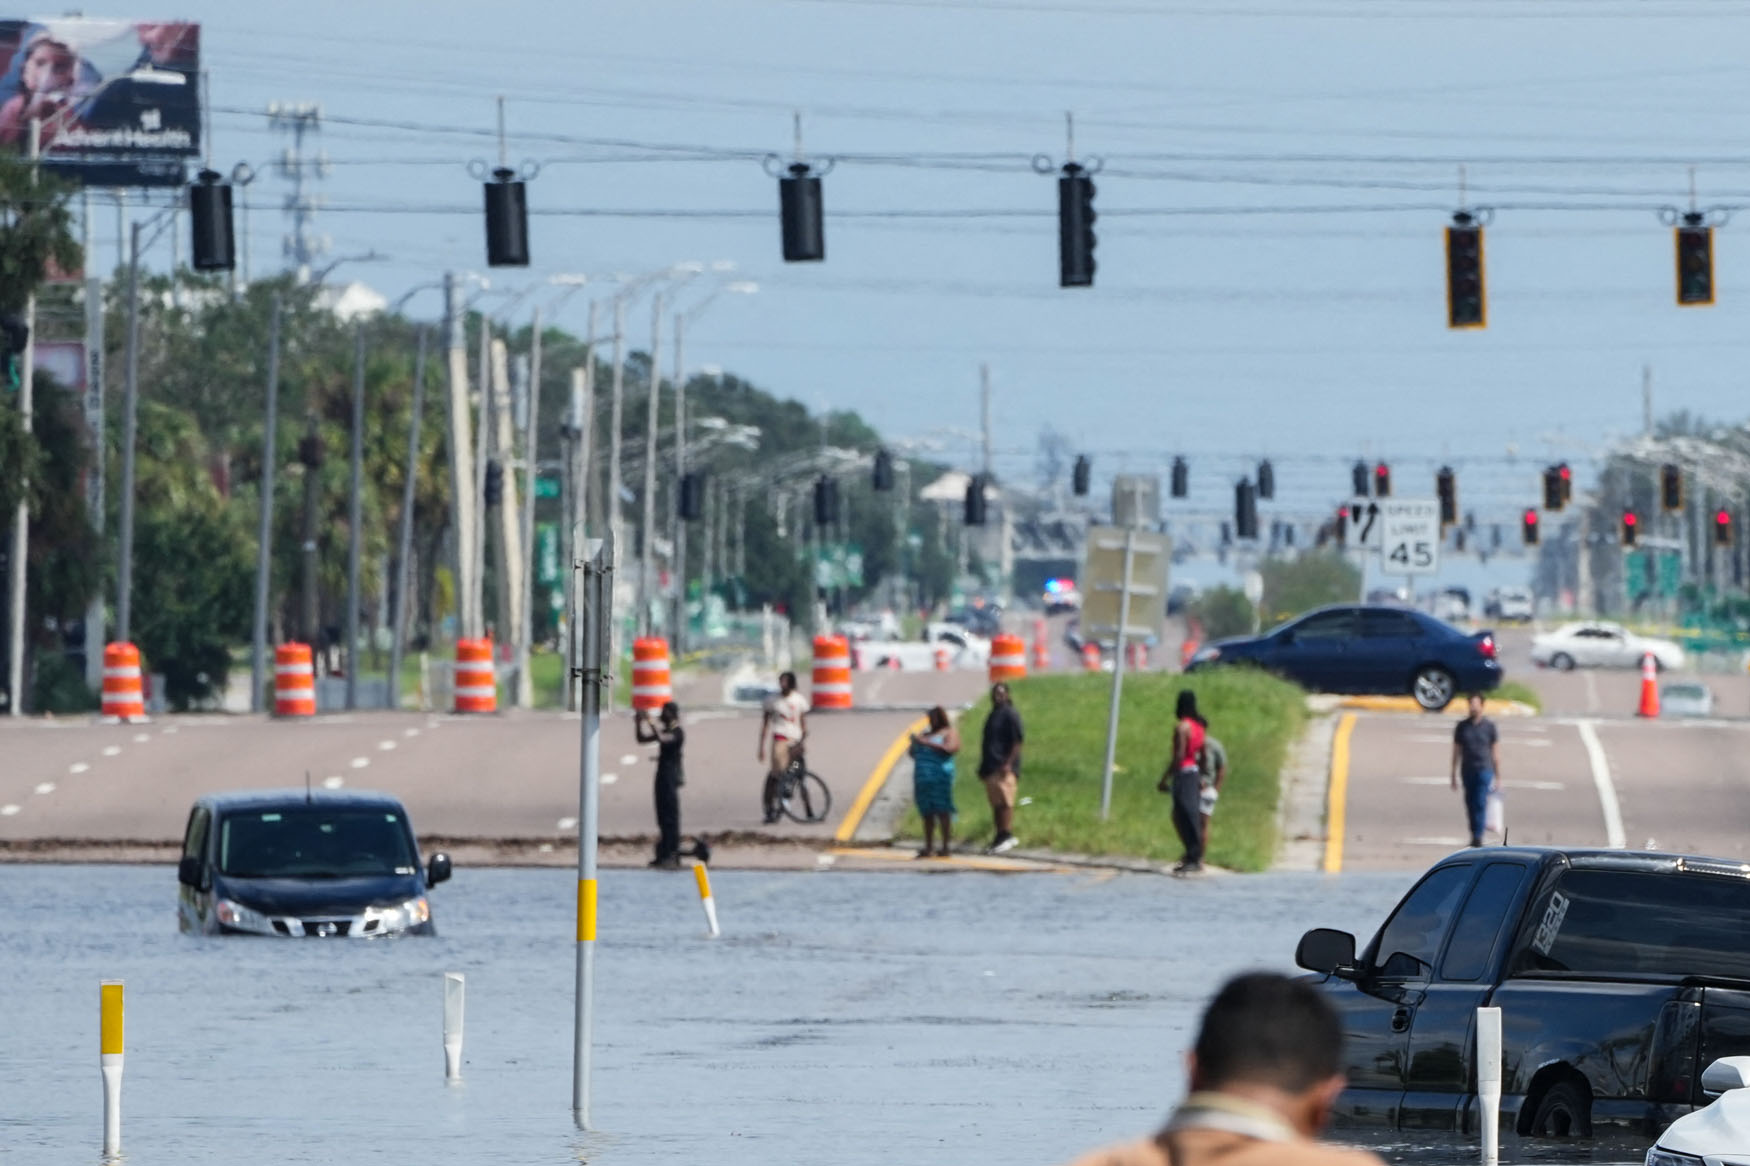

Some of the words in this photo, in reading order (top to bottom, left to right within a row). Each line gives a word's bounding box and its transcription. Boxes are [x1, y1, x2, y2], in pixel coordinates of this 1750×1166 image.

[1388, 505, 1433, 516] SPEED
[1391, 523, 1428, 536] LIMIT
[1389, 542, 1432, 567] 45
[1532, 891, 1564, 951] 1320
